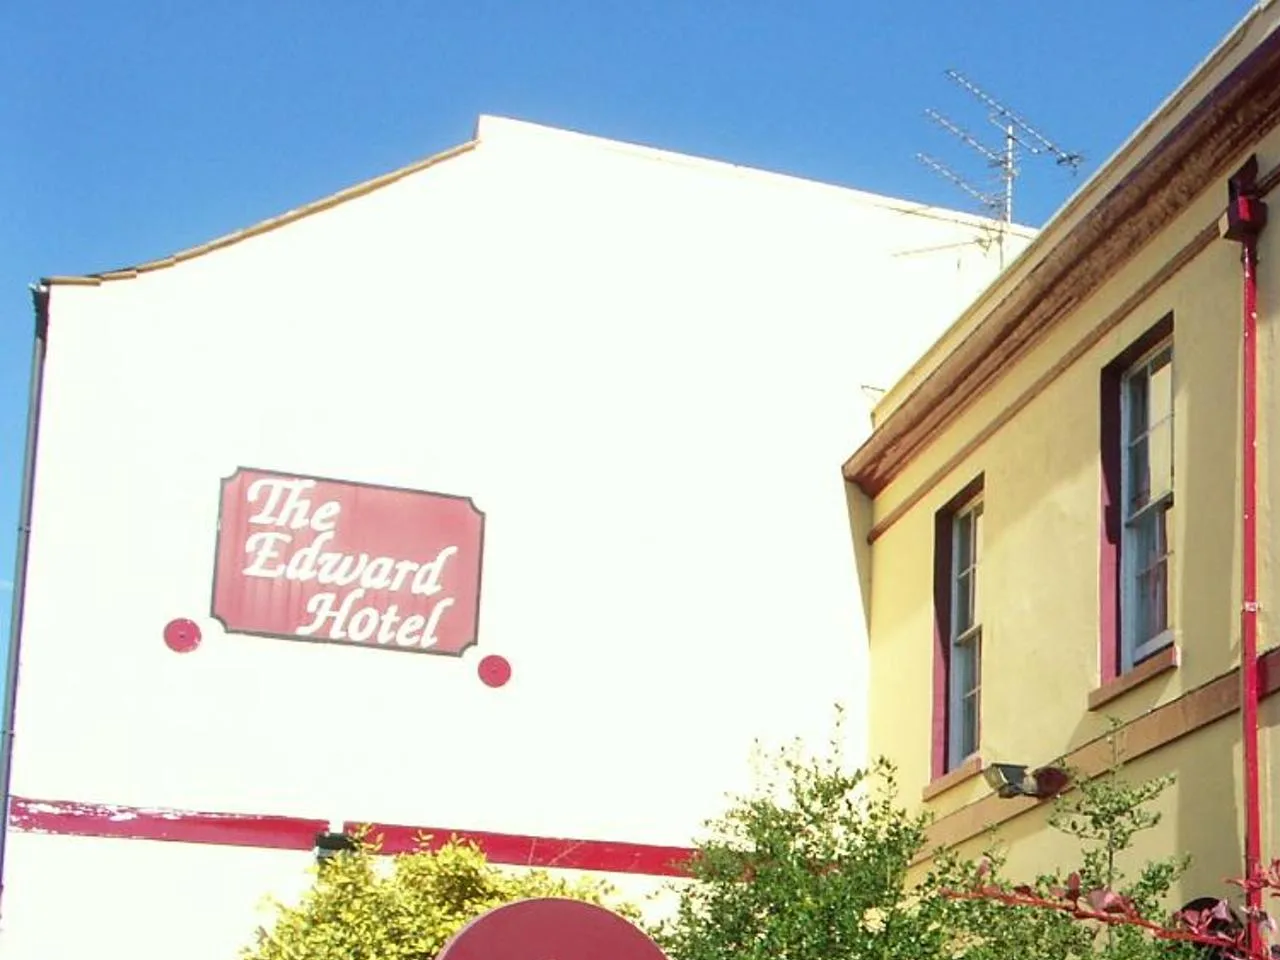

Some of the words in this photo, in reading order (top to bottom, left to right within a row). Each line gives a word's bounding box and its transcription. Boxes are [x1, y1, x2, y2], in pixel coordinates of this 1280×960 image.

[247, 477, 342, 532] The
[242, 530, 458, 597] Edward
[295, 588, 456, 648] Hotel
